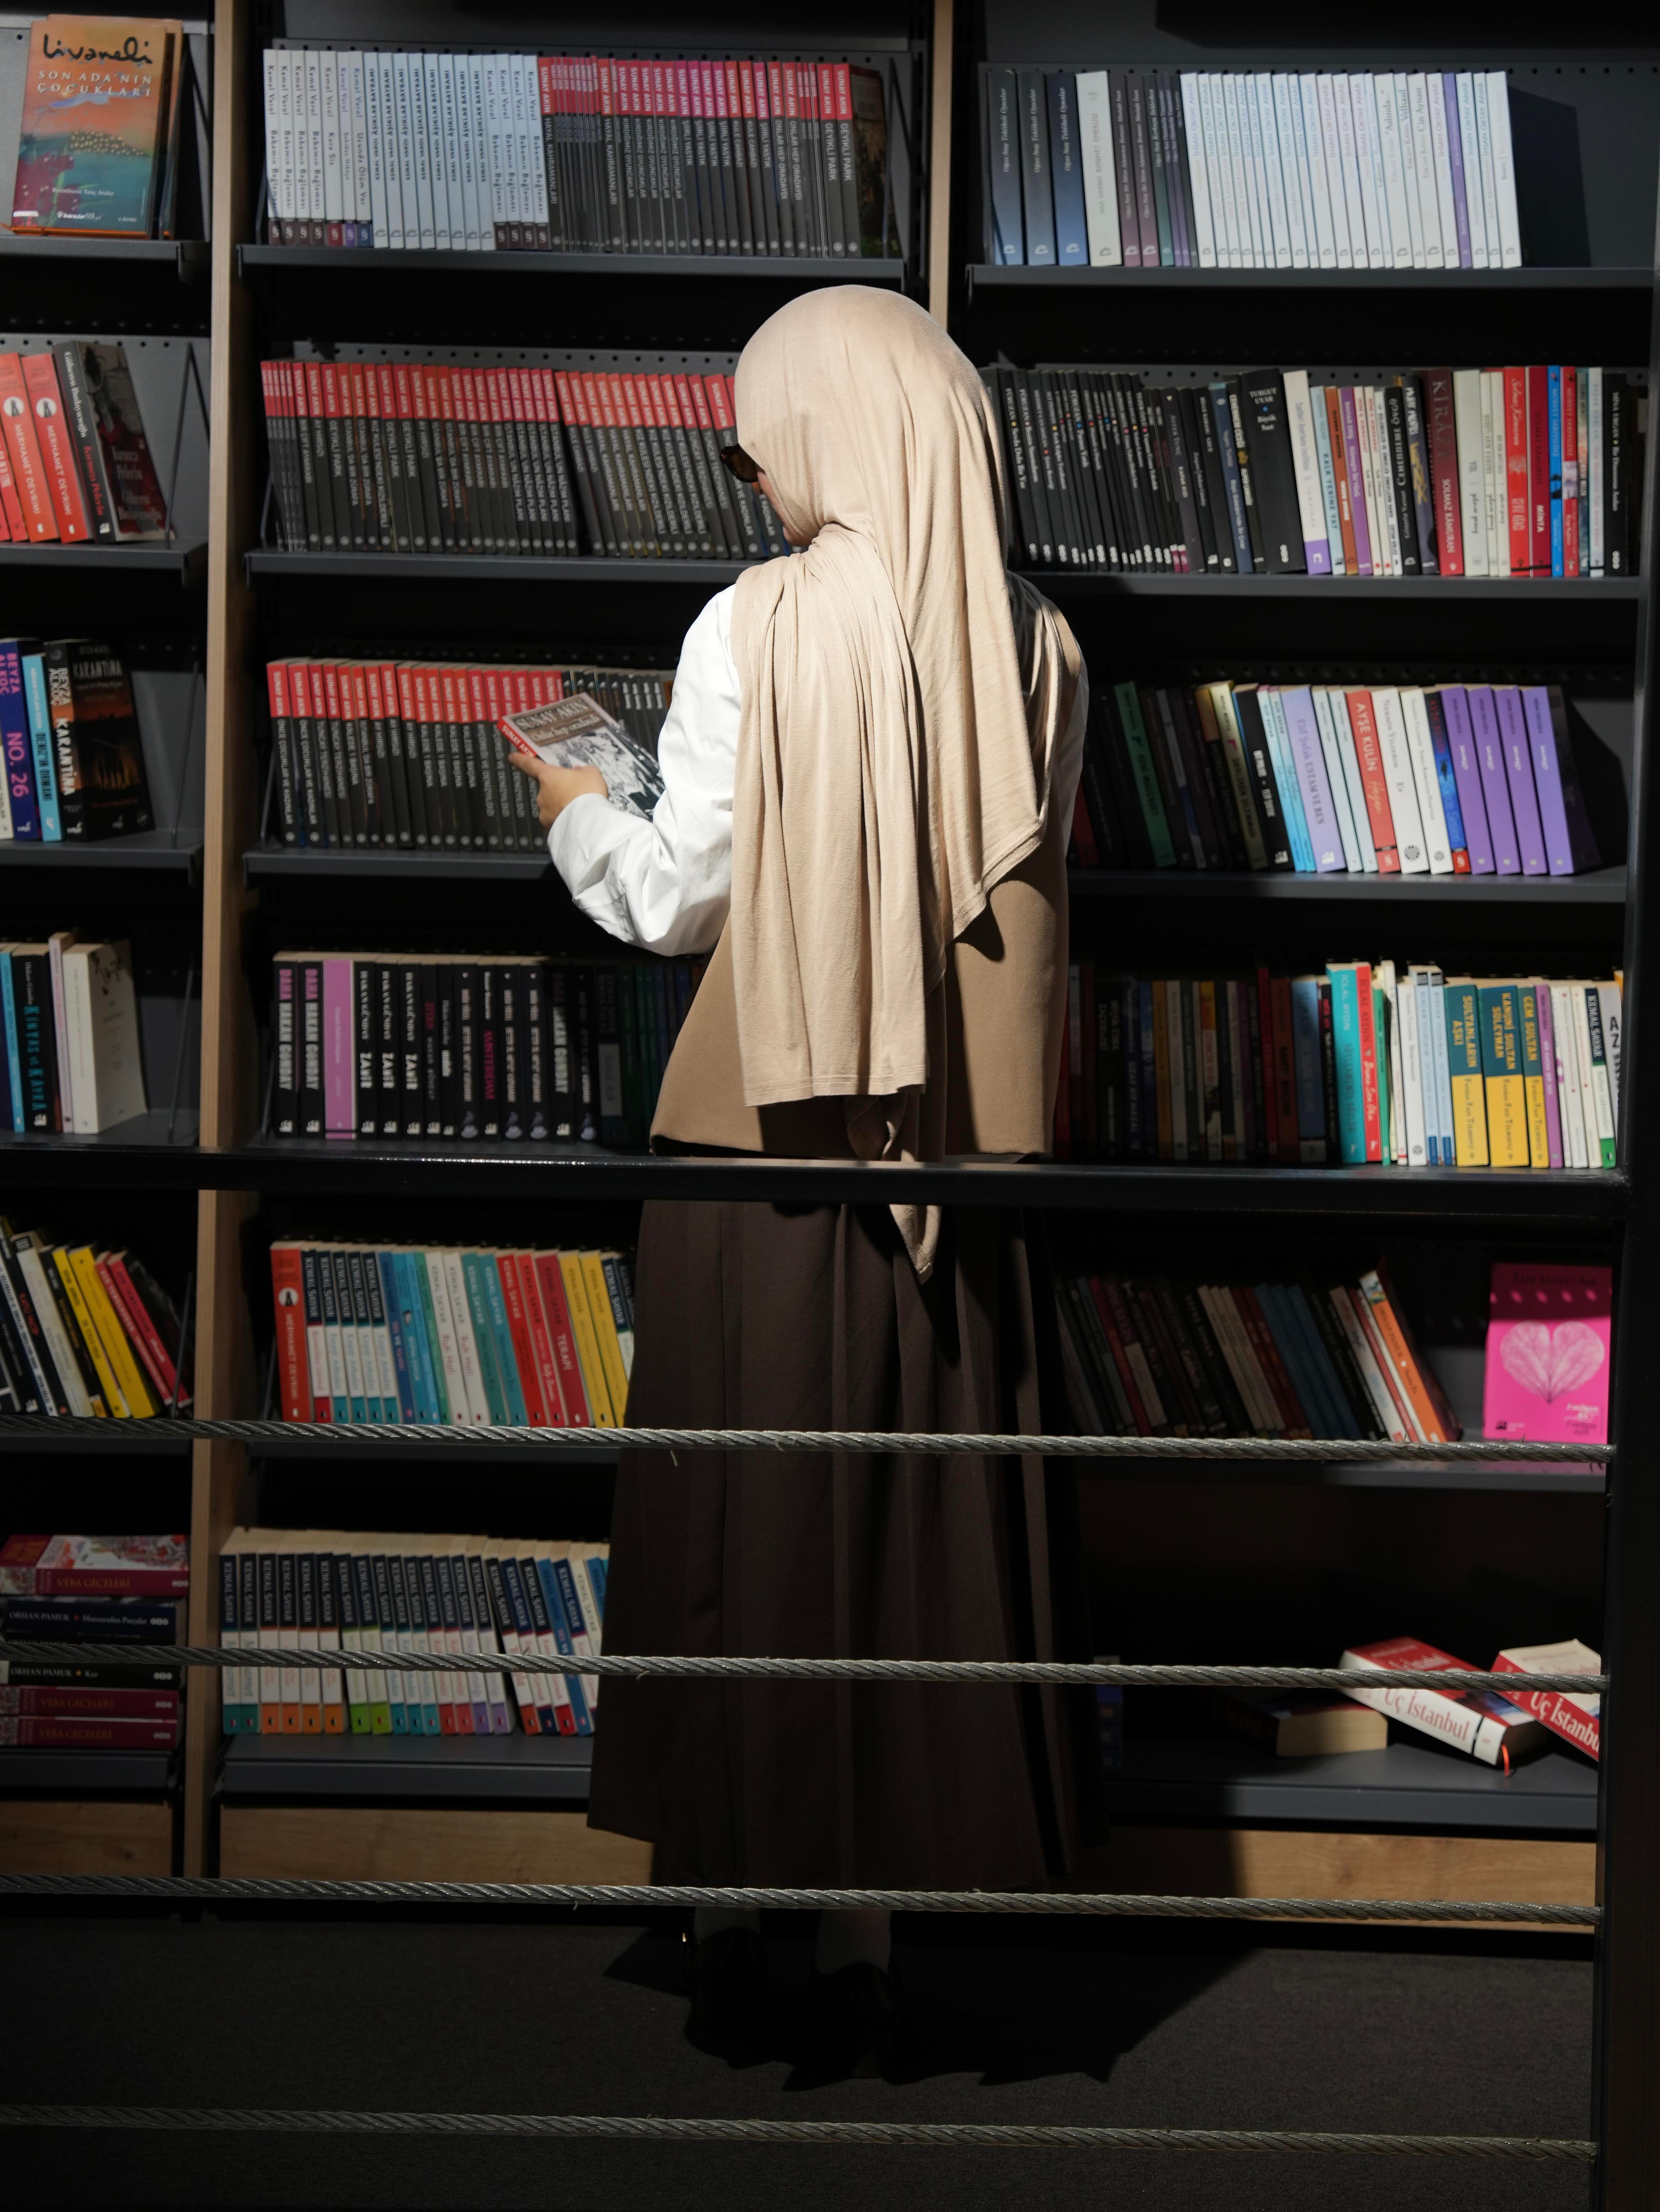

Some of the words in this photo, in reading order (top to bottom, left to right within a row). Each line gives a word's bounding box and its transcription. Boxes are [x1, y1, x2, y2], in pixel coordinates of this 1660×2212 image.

[37, 82, 151, 97] ÇOCUKLARI
[38, 70, 72, 80] SON
[79, 72, 152, 84] ADA'NIN
[368, 69, 377, 102] BAYRAMI
[473, 71, 482, 104] BAYRAMI
[540, 67, 549, 93] SUNAY
[741, 70, 751, 95] SUNAY
[756, 72, 765, 96] SUNAY
[785, 70, 794, 95] SUNAY
[837, 70, 846, 96] SUNAY
[543, 95, 551, 112] AKIN
[744, 95, 753, 113] AKIN
[758, 98, 766, 117] AKIN
[787, 97, 796, 116] AKIN
[839, 97, 848, 114] AKIN
[1202, 83, 1210, 104] ANAR
[746, 121, 755, 138] KULE
[789, 122, 798, 146] ONLAR
[1416, 116, 1425, 131] Cin
[312, 131, 320, 166] Babamın
[356, 133, 365, 163] Ucunda
[533, 136, 541, 170] Babamın
[748, 139, 757, 168] CANBAZI
[839, 123, 850, 155] GEYİKLİ
[1207, 134, 1216, 156] İHSAN
[762, 144, 770, 168] YASTIK
[791, 148, 799, 163] HEP
[842, 158, 852, 182] PARK
[358, 166, 366, 188] Ölüm
[546, 144, 557, 204] KAHRAMANLARI
[625, 155, 635, 198] OYUNCAKLAR
[311, 170, 321, 209] Bağlaması
[534, 174, 543, 214] Bağlaması
[294, 370, 303, 396] SUNAY
[309, 370, 318, 396] SUNAY
[296, 397, 305, 415] AKIN
[314, 419, 322, 429] AY
[46, 425, 64, 476] MERHAMET
[6, 653, 20, 694] BEYZA
[58, 667, 71, 705] BEYZA
[516, 710, 557, 730] SUNAY
[556, 699, 588, 719] AKIN
[1355, 703, 1370, 734] AYŞE
[6, 732, 25, 766] NO.
[502, 725, 522, 746] SUNAY
[519, 743, 536, 758] AKIN
[1361, 735, 1379, 771] KULİN
[55, 717, 77, 796] KARANTİNA
[10, 772, 29, 798] 26
[279, 968, 293, 1000] DAHA
[279, 1002, 292, 1042] HAKAN
[1501, 993, 1515, 1030] KANUNİ
[1523, 996, 1534, 1019] CEM
[1452, 1020, 1464, 1046] AŞKI
[1462, 995, 1478, 1068] SULTANLARIN
[1492, 1006, 1505, 1058] SÜLEYMAN
[1525, 1021, 1537, 1061] SULTAN
[1592, 1028, 1603, 1057] SAYAR
[1504, 1033, 1516, 1070] SULTAN
[56, 1578, 82, 1588] VEBA
[1384, 1688, 1405, 1713] Üç
[1407, 1690, 1471, 1742] İstanbul
[1530, 1691, 1551, 1720] Üç
[1549, 1696, 1599, 1753] İstanbu
